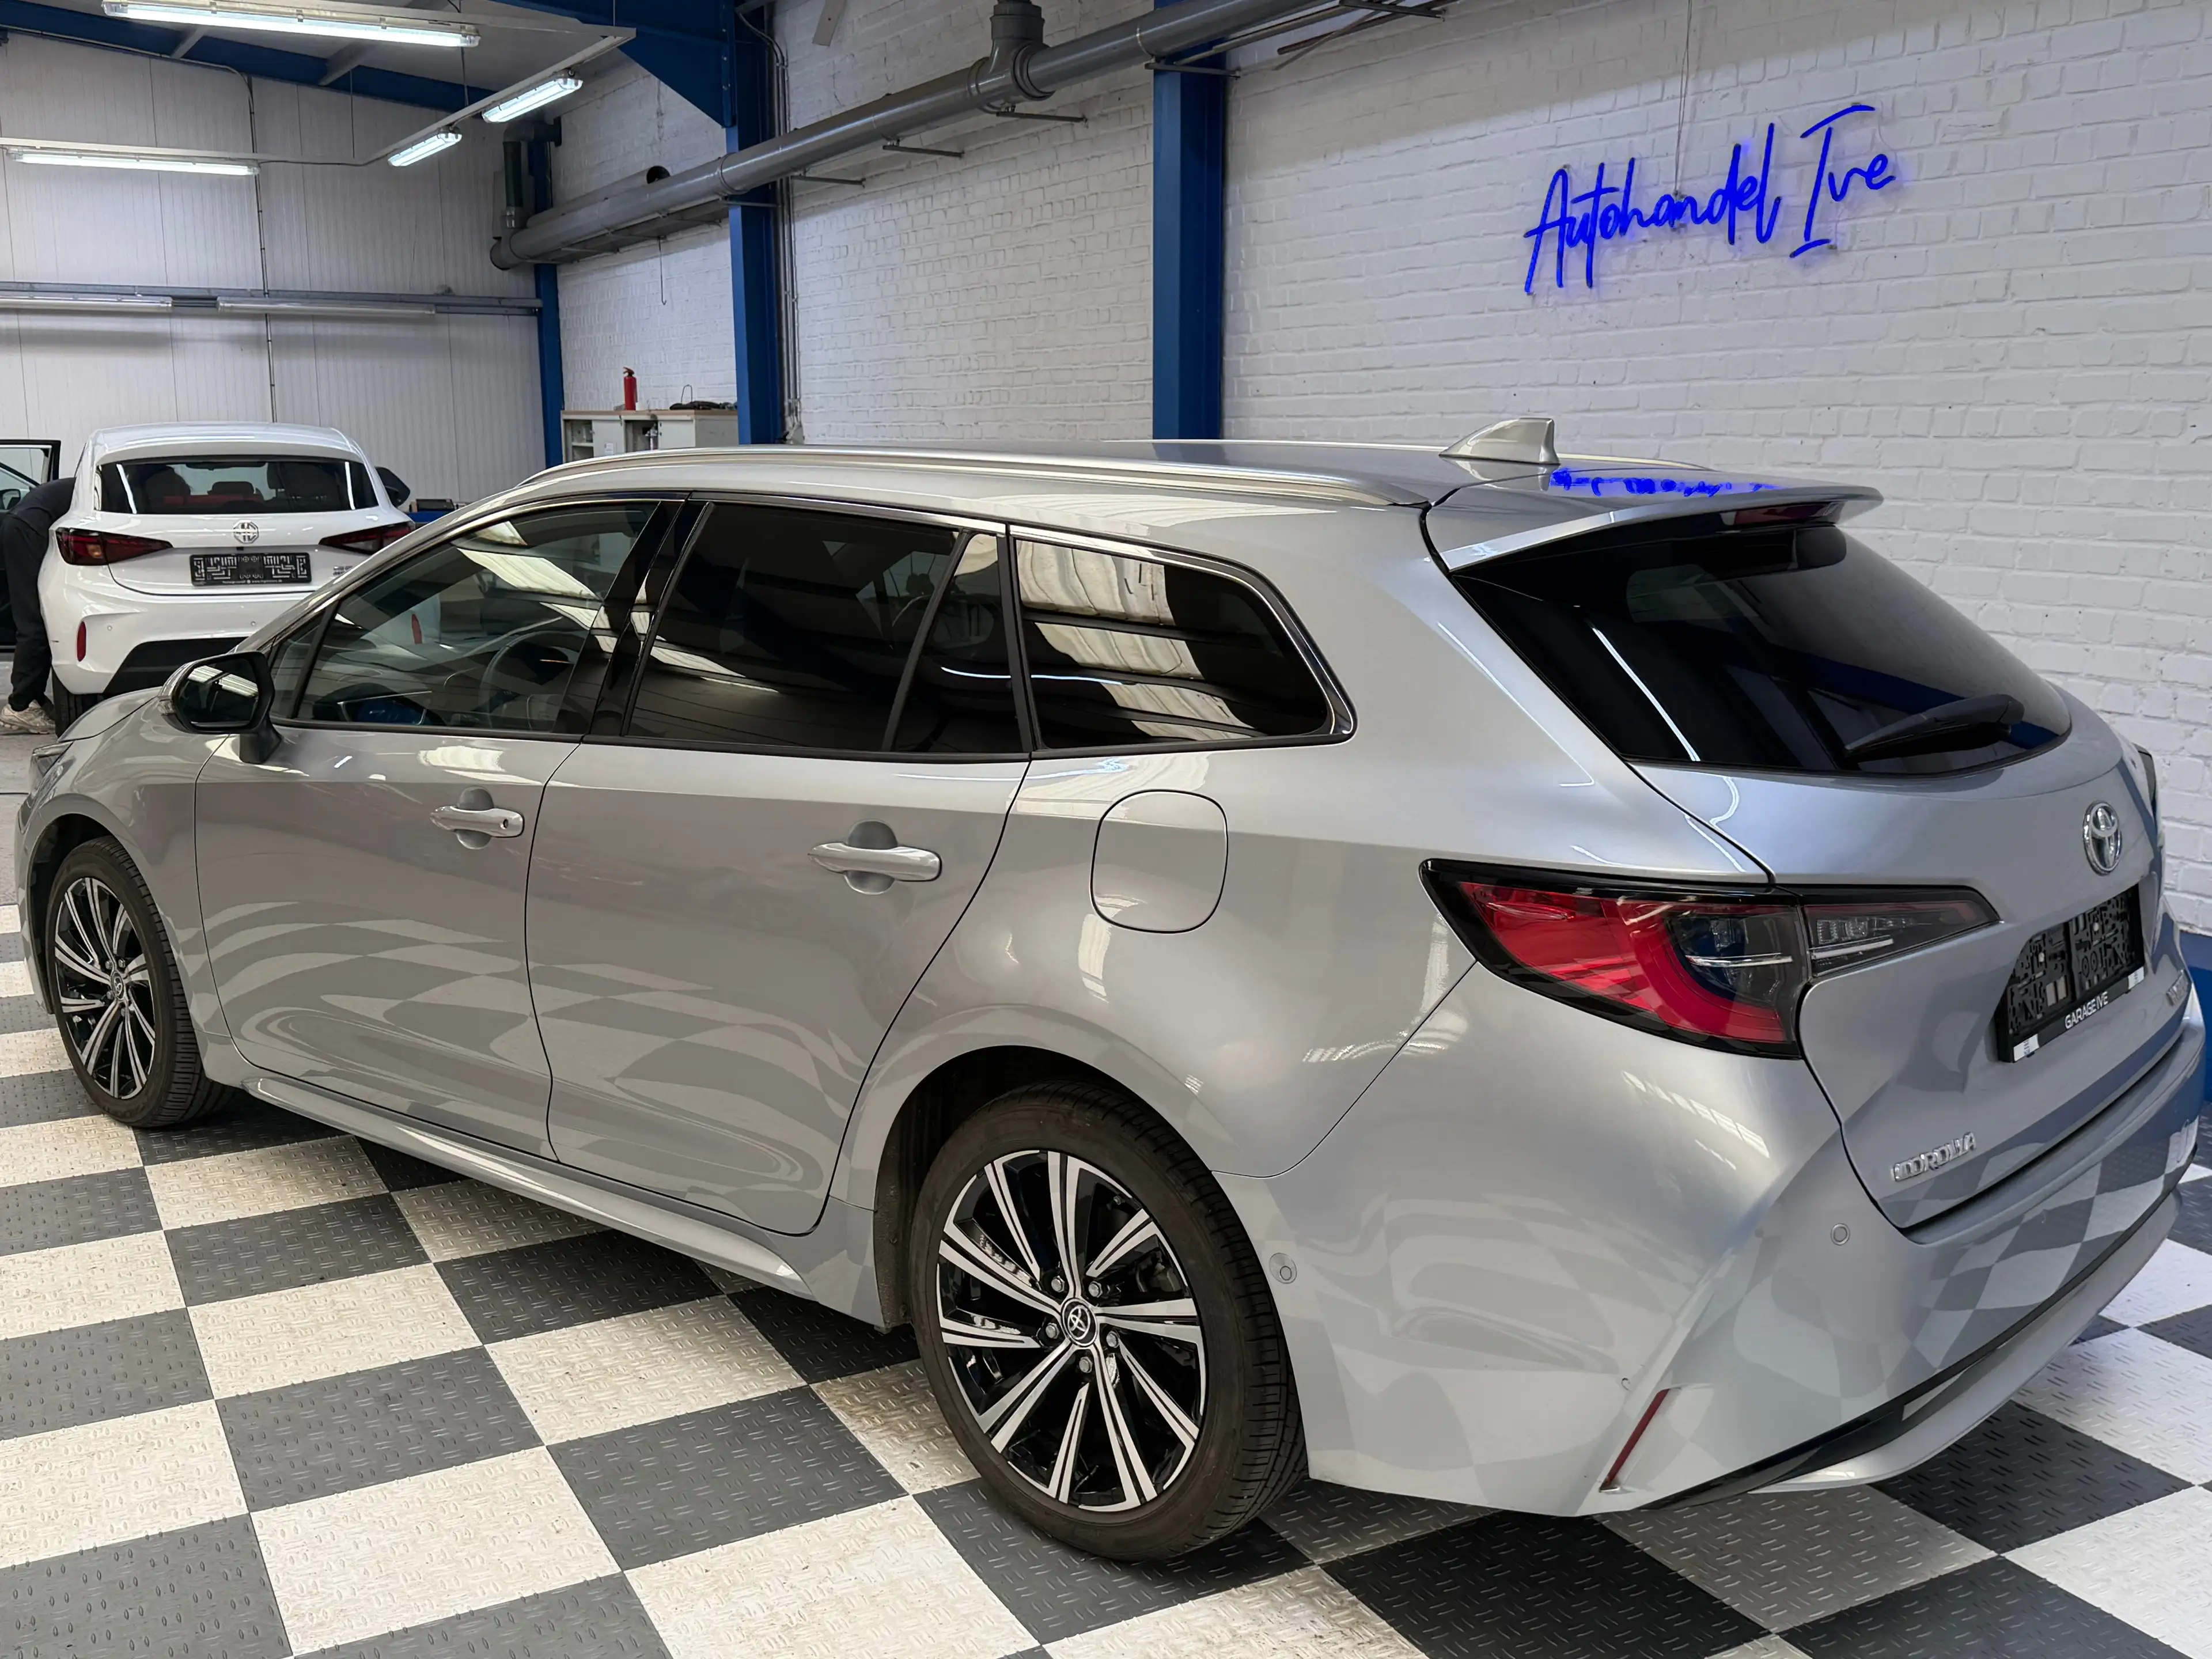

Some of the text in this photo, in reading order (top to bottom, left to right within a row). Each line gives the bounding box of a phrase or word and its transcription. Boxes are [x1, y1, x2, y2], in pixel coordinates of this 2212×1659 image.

[1524, 105, 1896, 294] Autohandel Ive
[2065, 998, 2097, 1029] GARAGE
